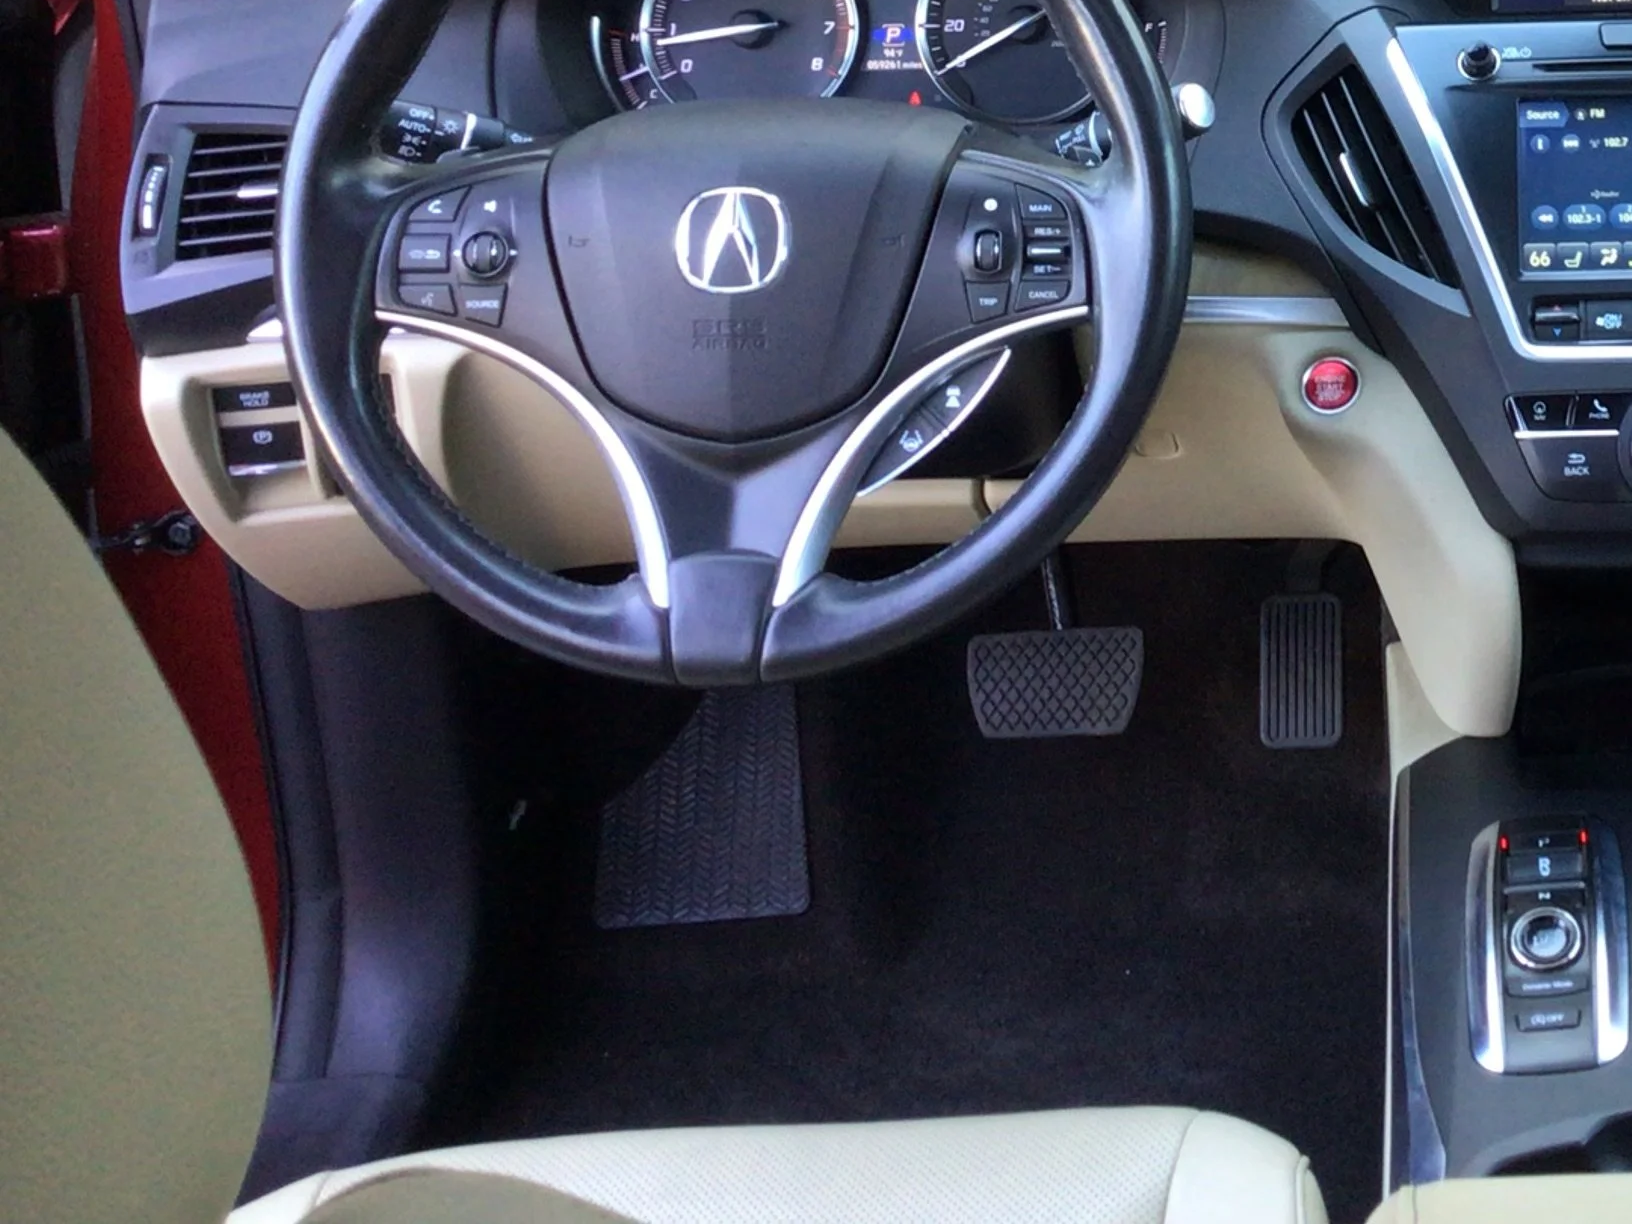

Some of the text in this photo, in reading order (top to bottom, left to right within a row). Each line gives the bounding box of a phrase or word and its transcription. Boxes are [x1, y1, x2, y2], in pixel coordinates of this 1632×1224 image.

[824, 22, 835, 34] 7
[944, 19, 965, 32] 20
[886, 27, 901, 43] P
[680, 60, 693, 72] 0
[811, 58, 823, 71] 8
[409, 108, 429, 118] OFF
[1526, 110, 1560, 120] Source
[1590, 108, 1606, 119] FM
[399, 121, 426, 133] AUTO
[1604, 137, 1629, 148] 102.7
[1029, 204, 1052, 212] MAIN
[1529, 251, 1551, 267] 66
[1028, 291, 1058, 299] CANCEL
[466, 300, 499, 309] SOURCE
[979, 298, 998, 306] TRIP
[1564, 466, 1590, 476] BACK
